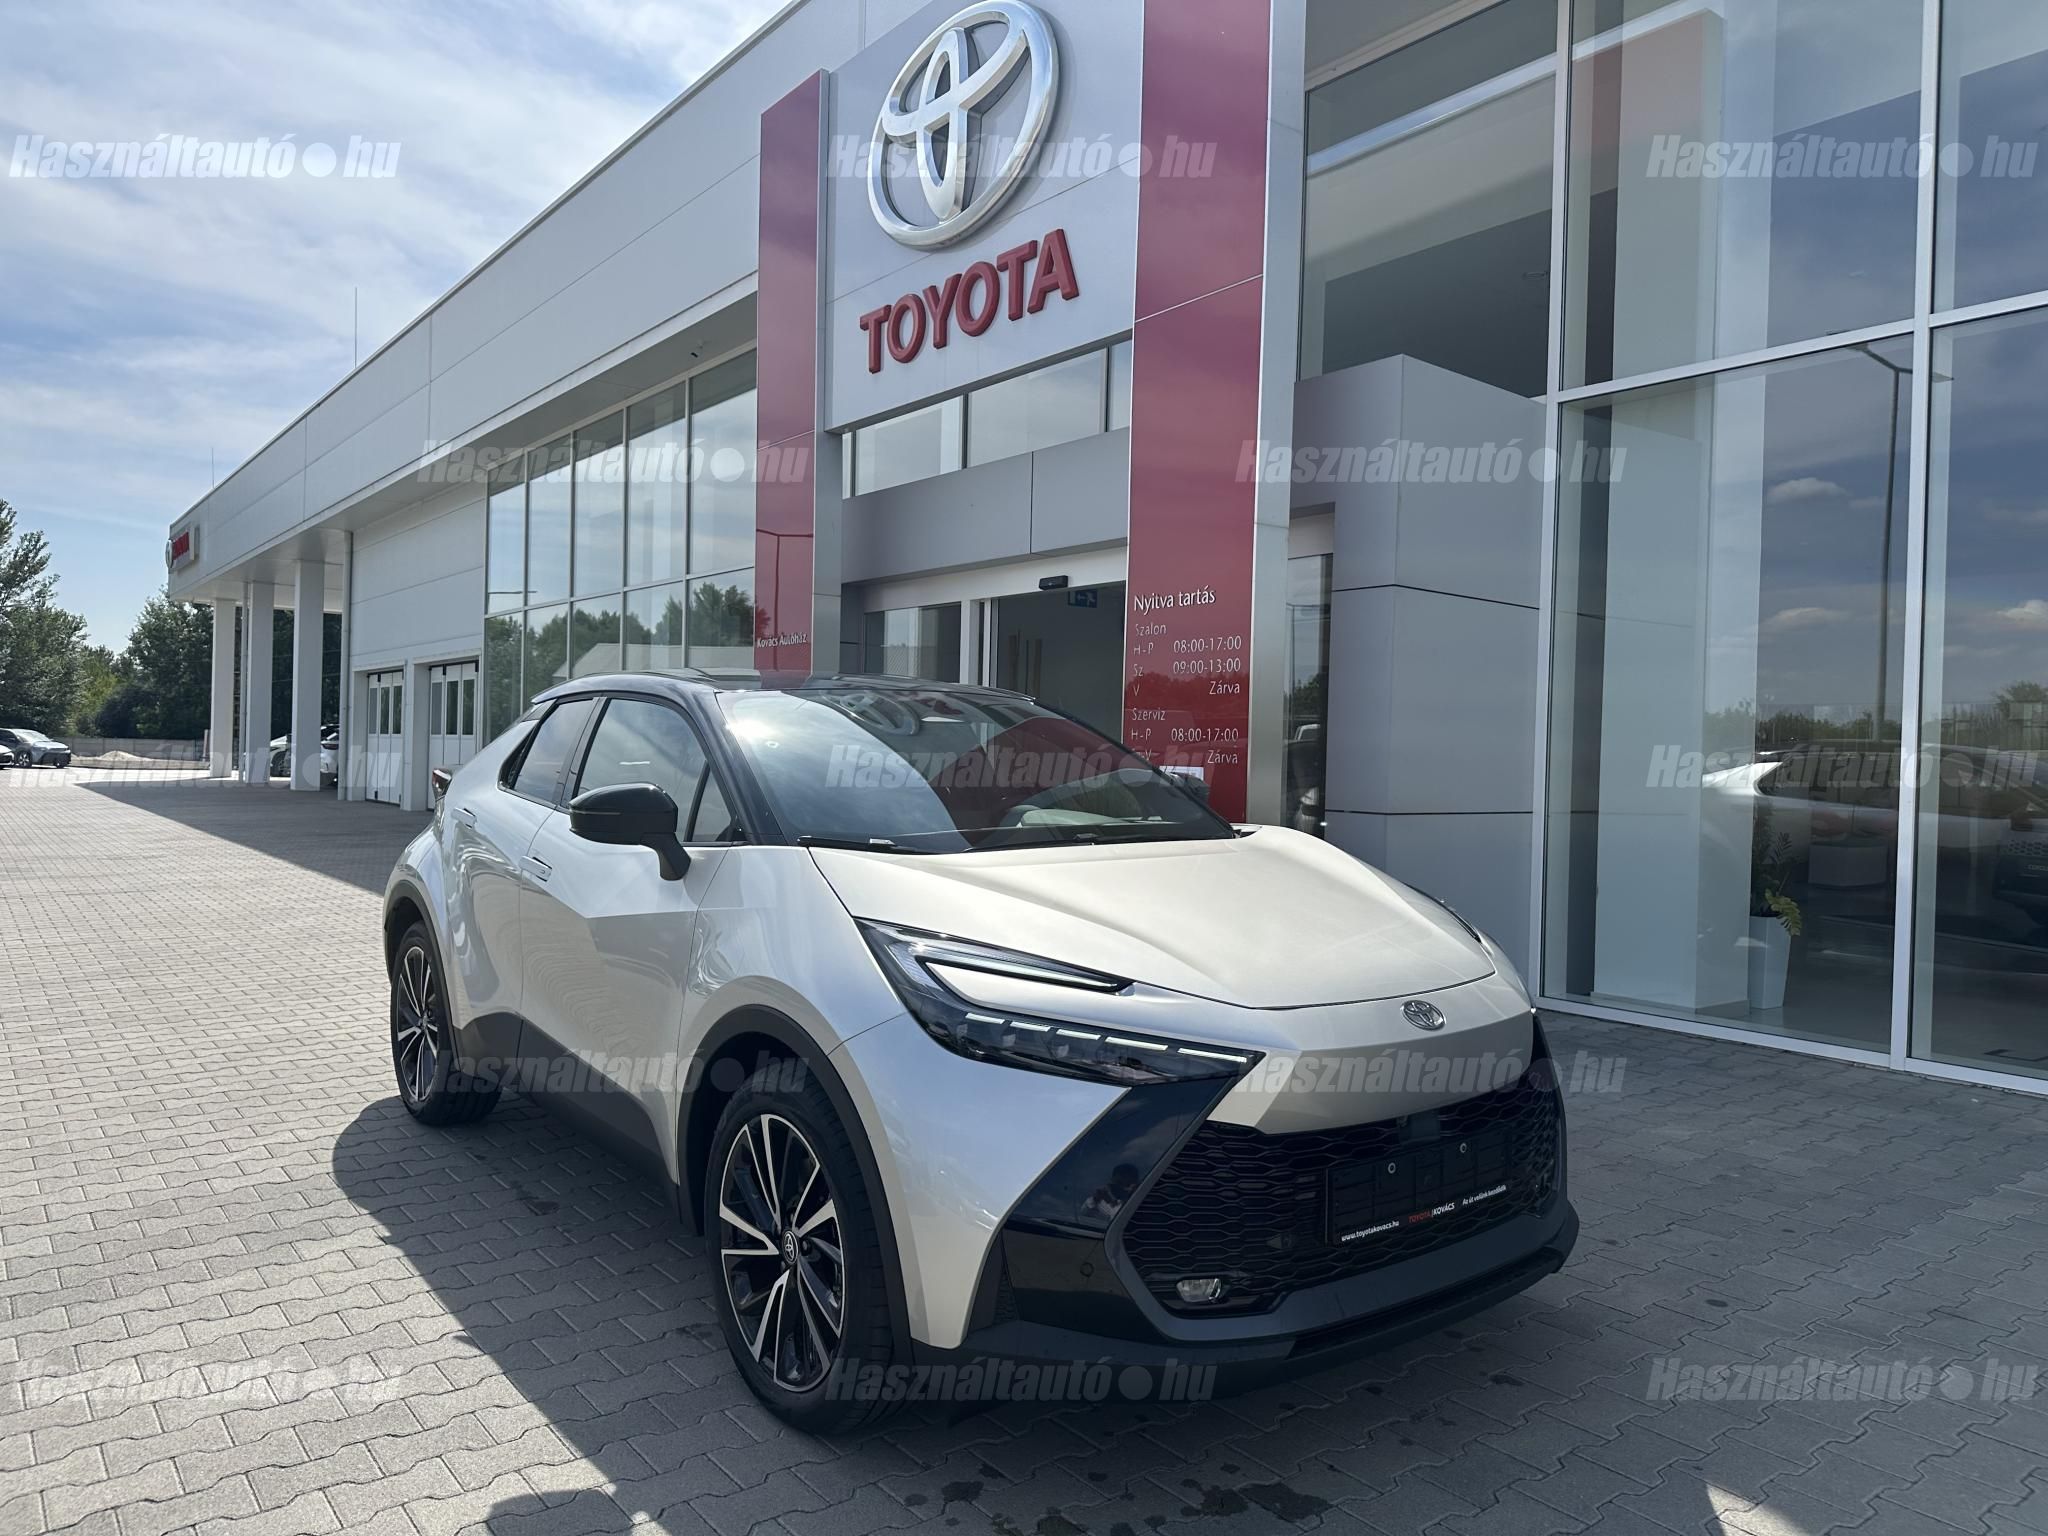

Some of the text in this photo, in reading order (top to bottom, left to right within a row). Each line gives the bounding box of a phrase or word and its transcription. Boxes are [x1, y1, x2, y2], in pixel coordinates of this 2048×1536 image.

[860, 228, 1079, 374] TOYOTA
[1134, 585, 1216, 615] Nyitva tartás
[1135, 622, 1167, 636] Szalon
[1173, 635, 1242, 654] 08:00-17:00
[1133, 658, 1241, 677] Sz 09:00-13:00
[1133, 681, 1240, 697] V Zárva
[1132, 707, 1166, 721] Szerviz
[1171, 728, 1239, 742] 08:00-17:00
[1207, 749, 1238, 764] Zárva
[1341, 1220, 1399, 1242] www.toyotakovacs.hu
